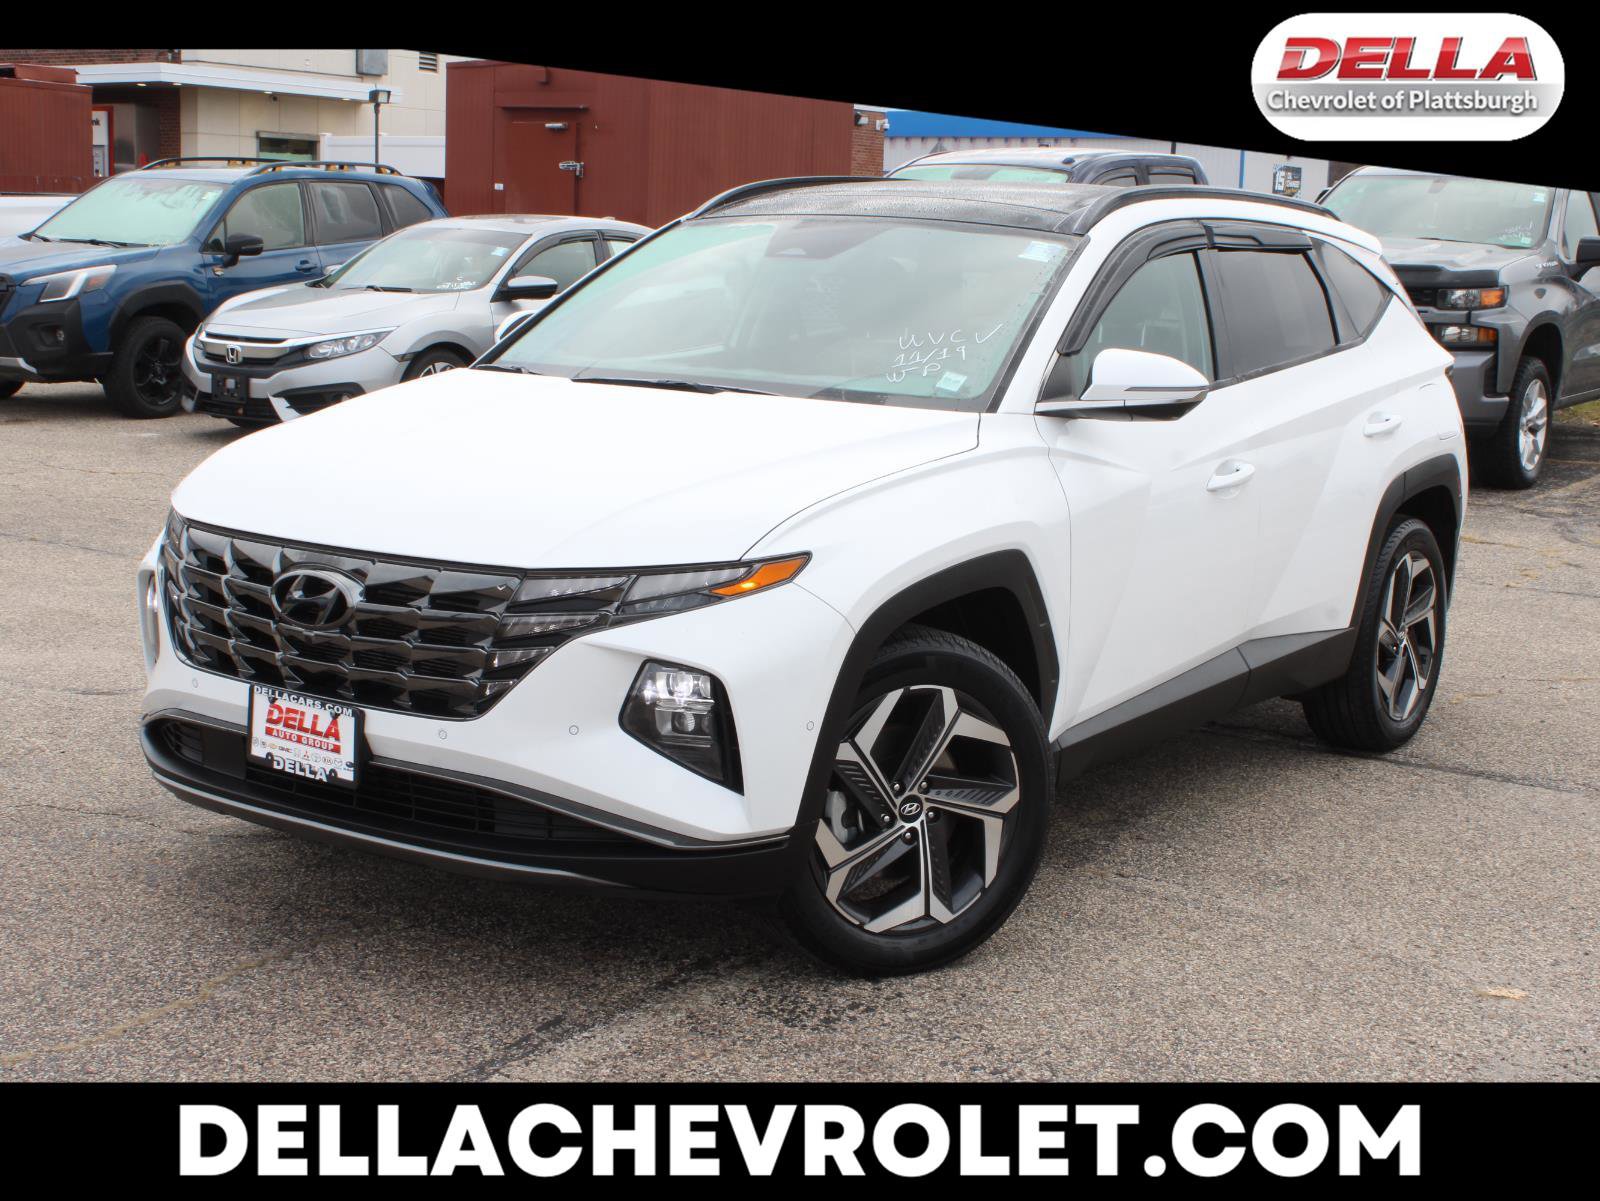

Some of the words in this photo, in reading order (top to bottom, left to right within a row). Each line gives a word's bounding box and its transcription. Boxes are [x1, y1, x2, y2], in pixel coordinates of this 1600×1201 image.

[253, 685, 353, 717] DELLACARS.COM
[265, 702, 341, 741] DELLA
[272, 727, 298, 743] AUTO
[301, 736, 335, 751] GROUP
[273, 755, 328, 782] DELLA
